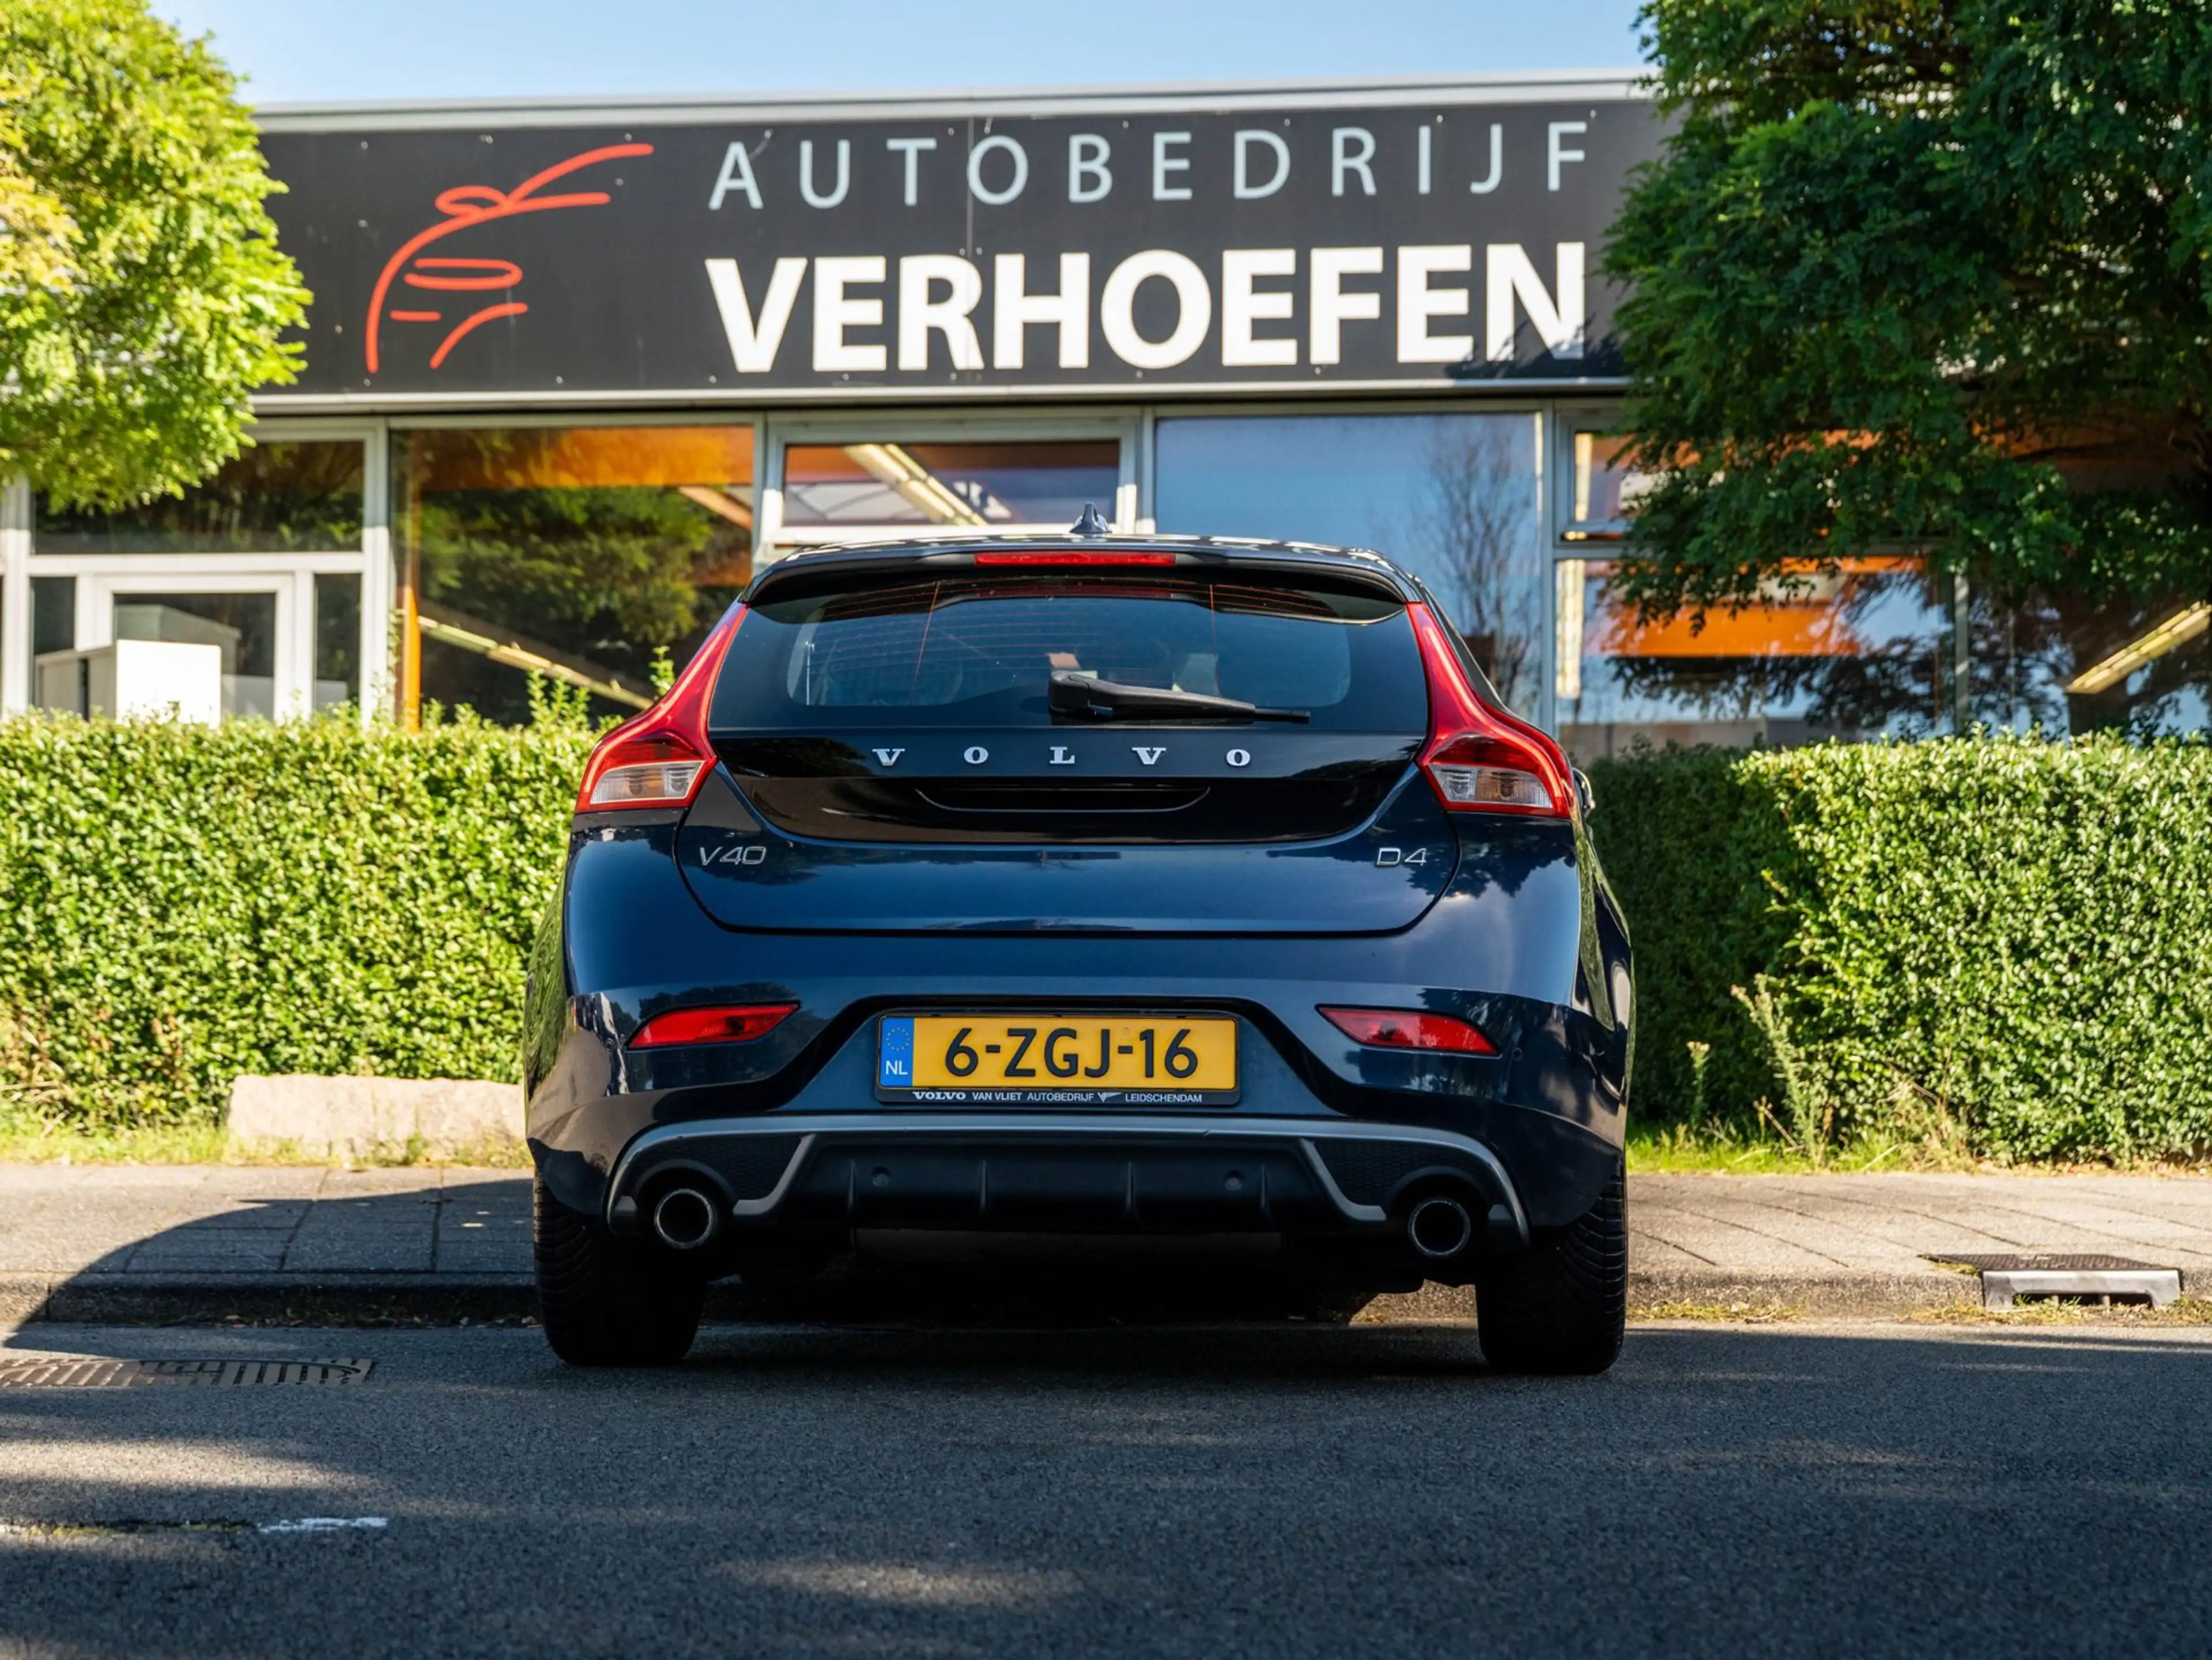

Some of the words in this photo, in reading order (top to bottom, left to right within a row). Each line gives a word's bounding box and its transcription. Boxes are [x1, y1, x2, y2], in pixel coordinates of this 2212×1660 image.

[708, 122, 1588, 209] AUTOBEDRIJF
[705, 242, 1586, 373] VERHOEFEN
[873, 746, 1251, 767] VOLVO
[699, 846, 767, 866] V40
[1376, 848, 1427, 866] D4
[945, 1028, 1198, 1078] 6-ZGJ-16
[885, 1061, 908, 1076] NL
[913, 1091, 966, 1100] VOLVO
[972, 1092, 992, 1100] VAN
[995, 1092, 1022, 1101] VLIET
[1027, 1093, 1094, 1101] AUTOBEDRIJF
[1126, 1093, 1202, 1103] LEIDSCHENDAM
